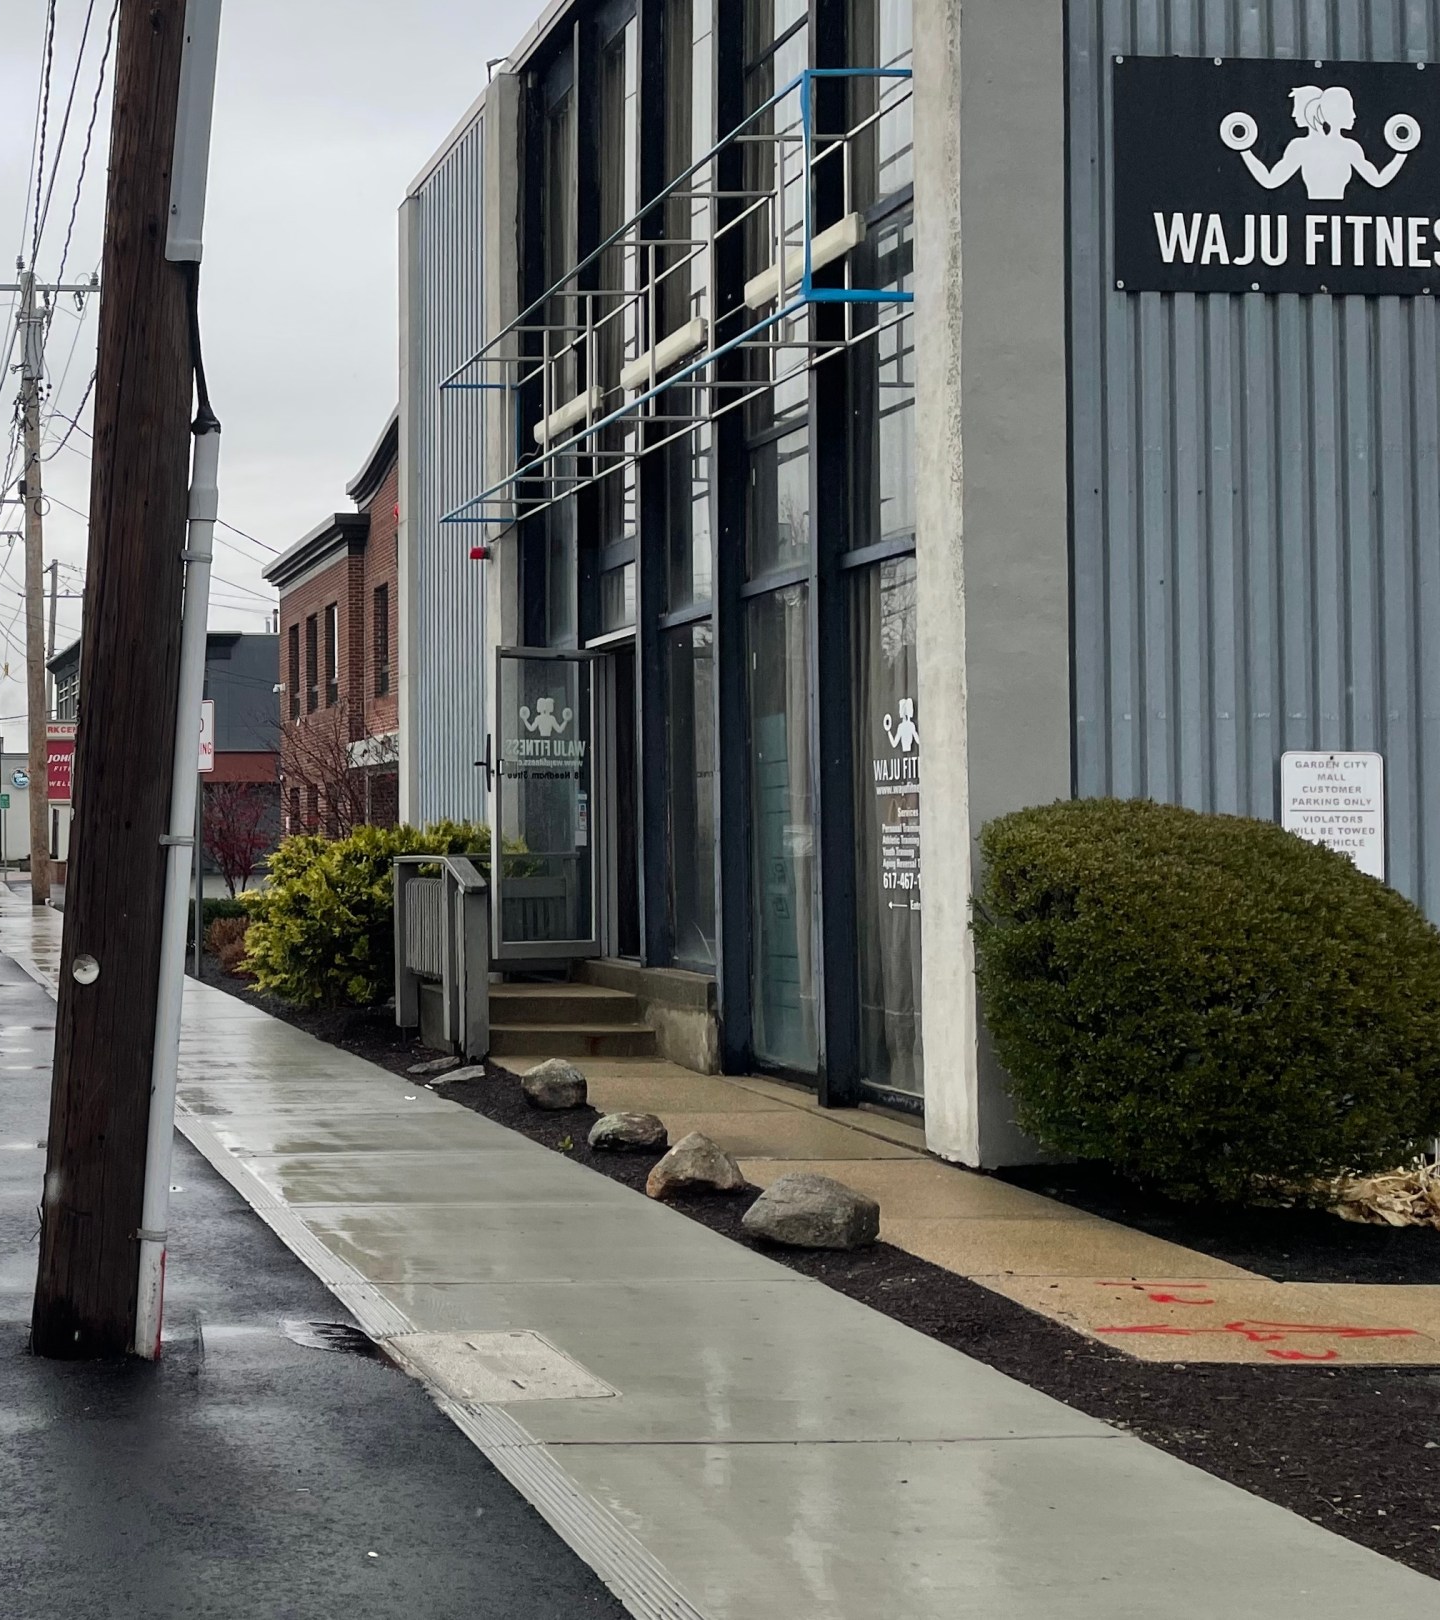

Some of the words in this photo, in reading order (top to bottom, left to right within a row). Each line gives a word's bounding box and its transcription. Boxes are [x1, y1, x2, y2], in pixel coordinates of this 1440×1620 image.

[1154, 211, 1288, 266] WAJU
[1306, 214, 1440, 269] FITNE
[873, 758, 901, 781] WAJU
[903, 756, 920, 779] FIT
[1295, 760, 1340, 769] GARDEN
[1344, 760, 1368, 769] CITY
[1318, 773, 1346, 782] MALL
[1302, 786, 1362, 794] CUSTOMER
[1292, 798, 1340, 806] PARKING
[1344, 798, 1372, 806] ONLY
[1302, 816, 1363, 824] VIOLATORS
[1290, 827, 1316, 835] WILL
[1320, 827, 1334, 835] BE
[1338, 827, 1375, 836] TOWED
[1318, 838, 1366, 847] EHICLE
